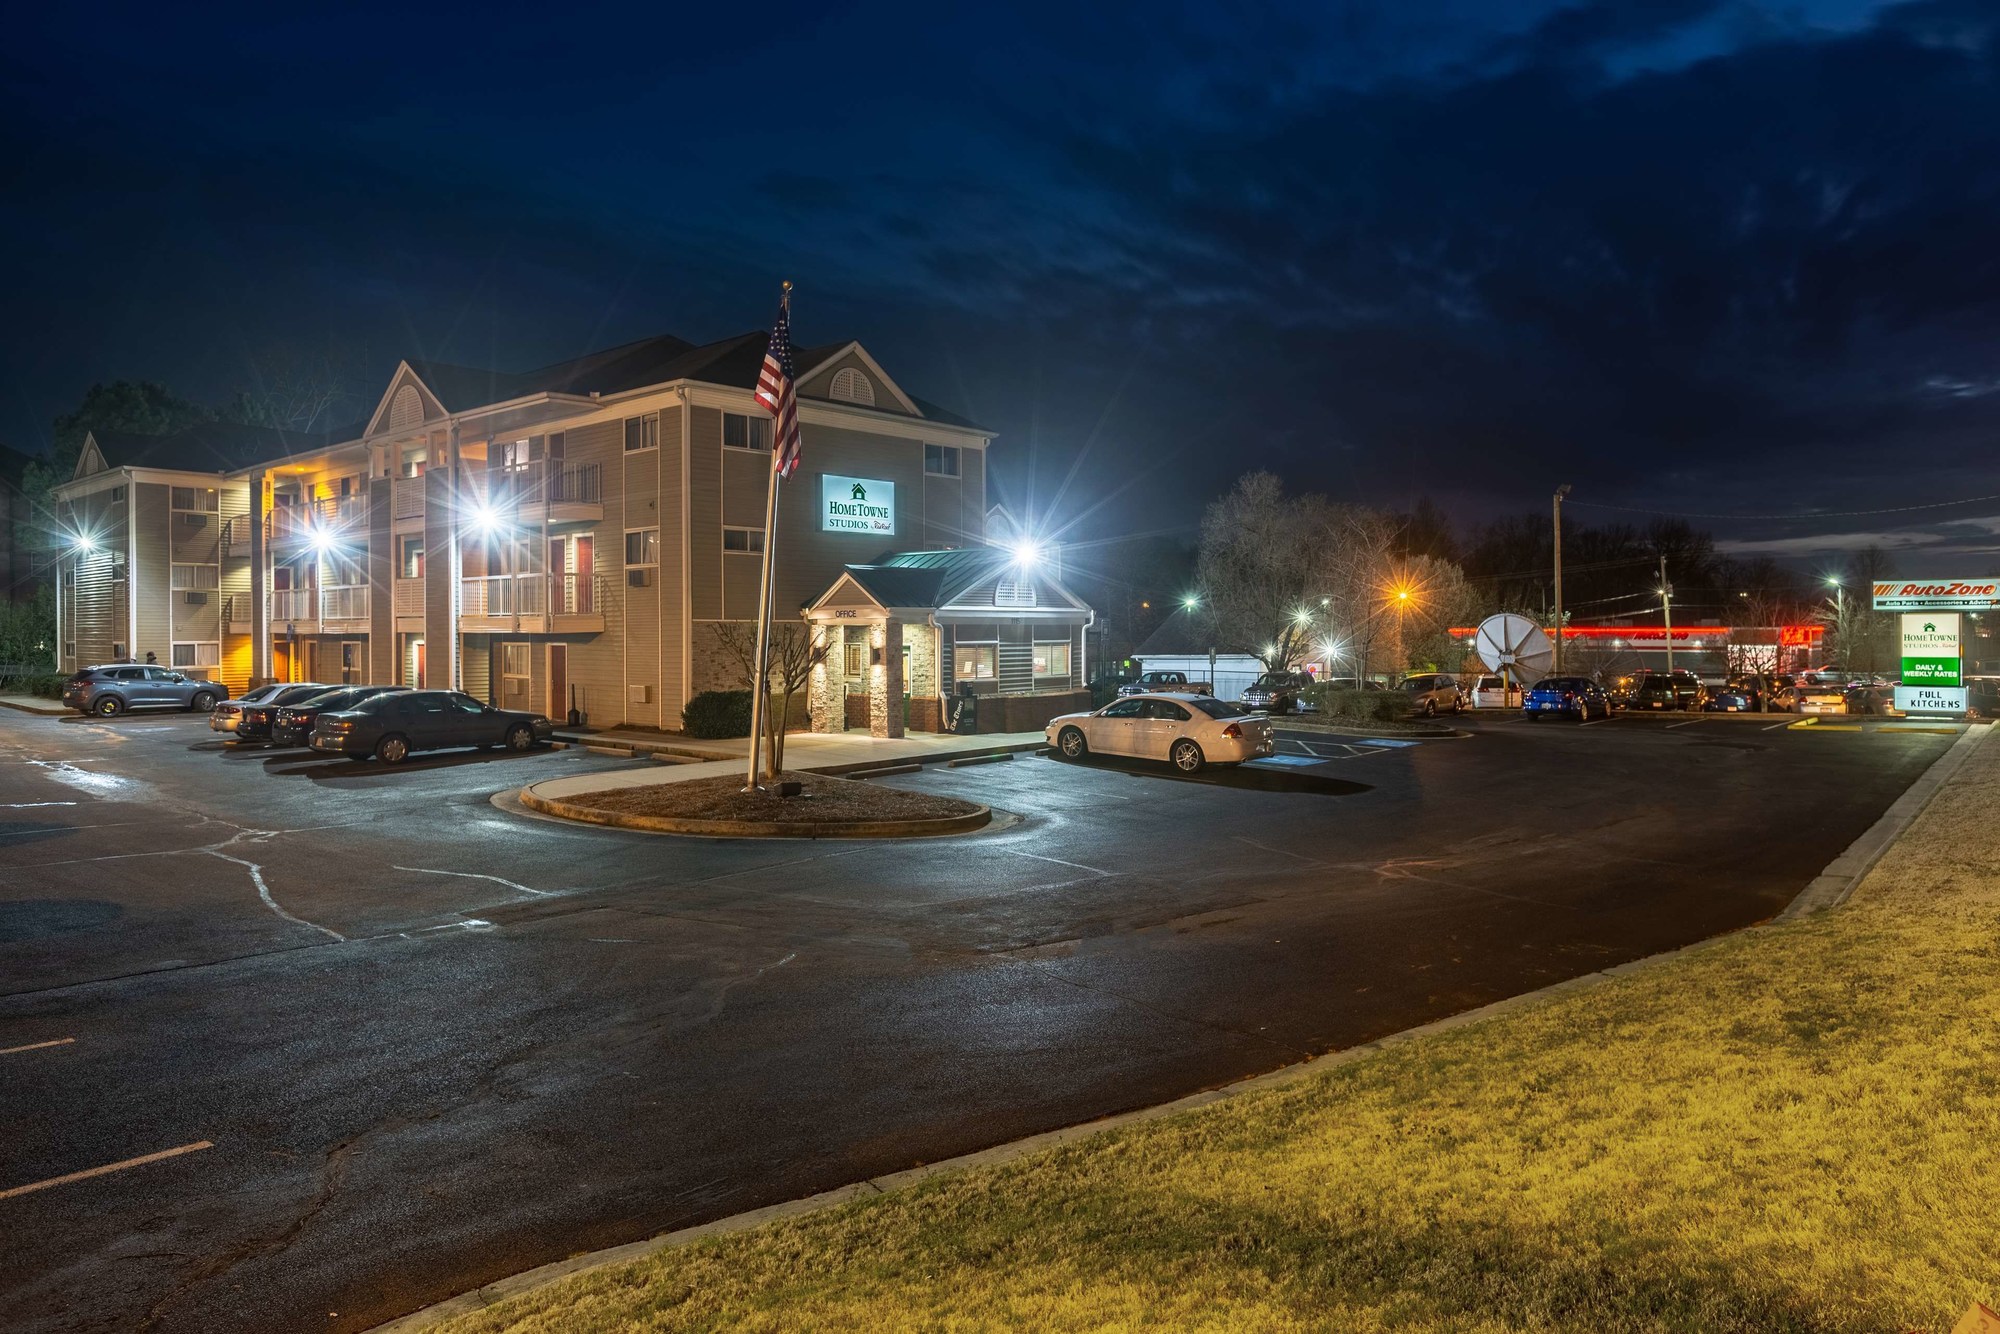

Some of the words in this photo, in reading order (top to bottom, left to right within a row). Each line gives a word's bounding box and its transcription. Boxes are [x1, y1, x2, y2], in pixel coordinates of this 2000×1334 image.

[829, 519, 869, 530] STUDIOS
[1899, 583, 1996, 596] AutoZone
[835, 610, 857, 618] OFFICE
[1919, 691, 1942, 699] FULL
[1910, 700, 1960, 708] KITCHENS
